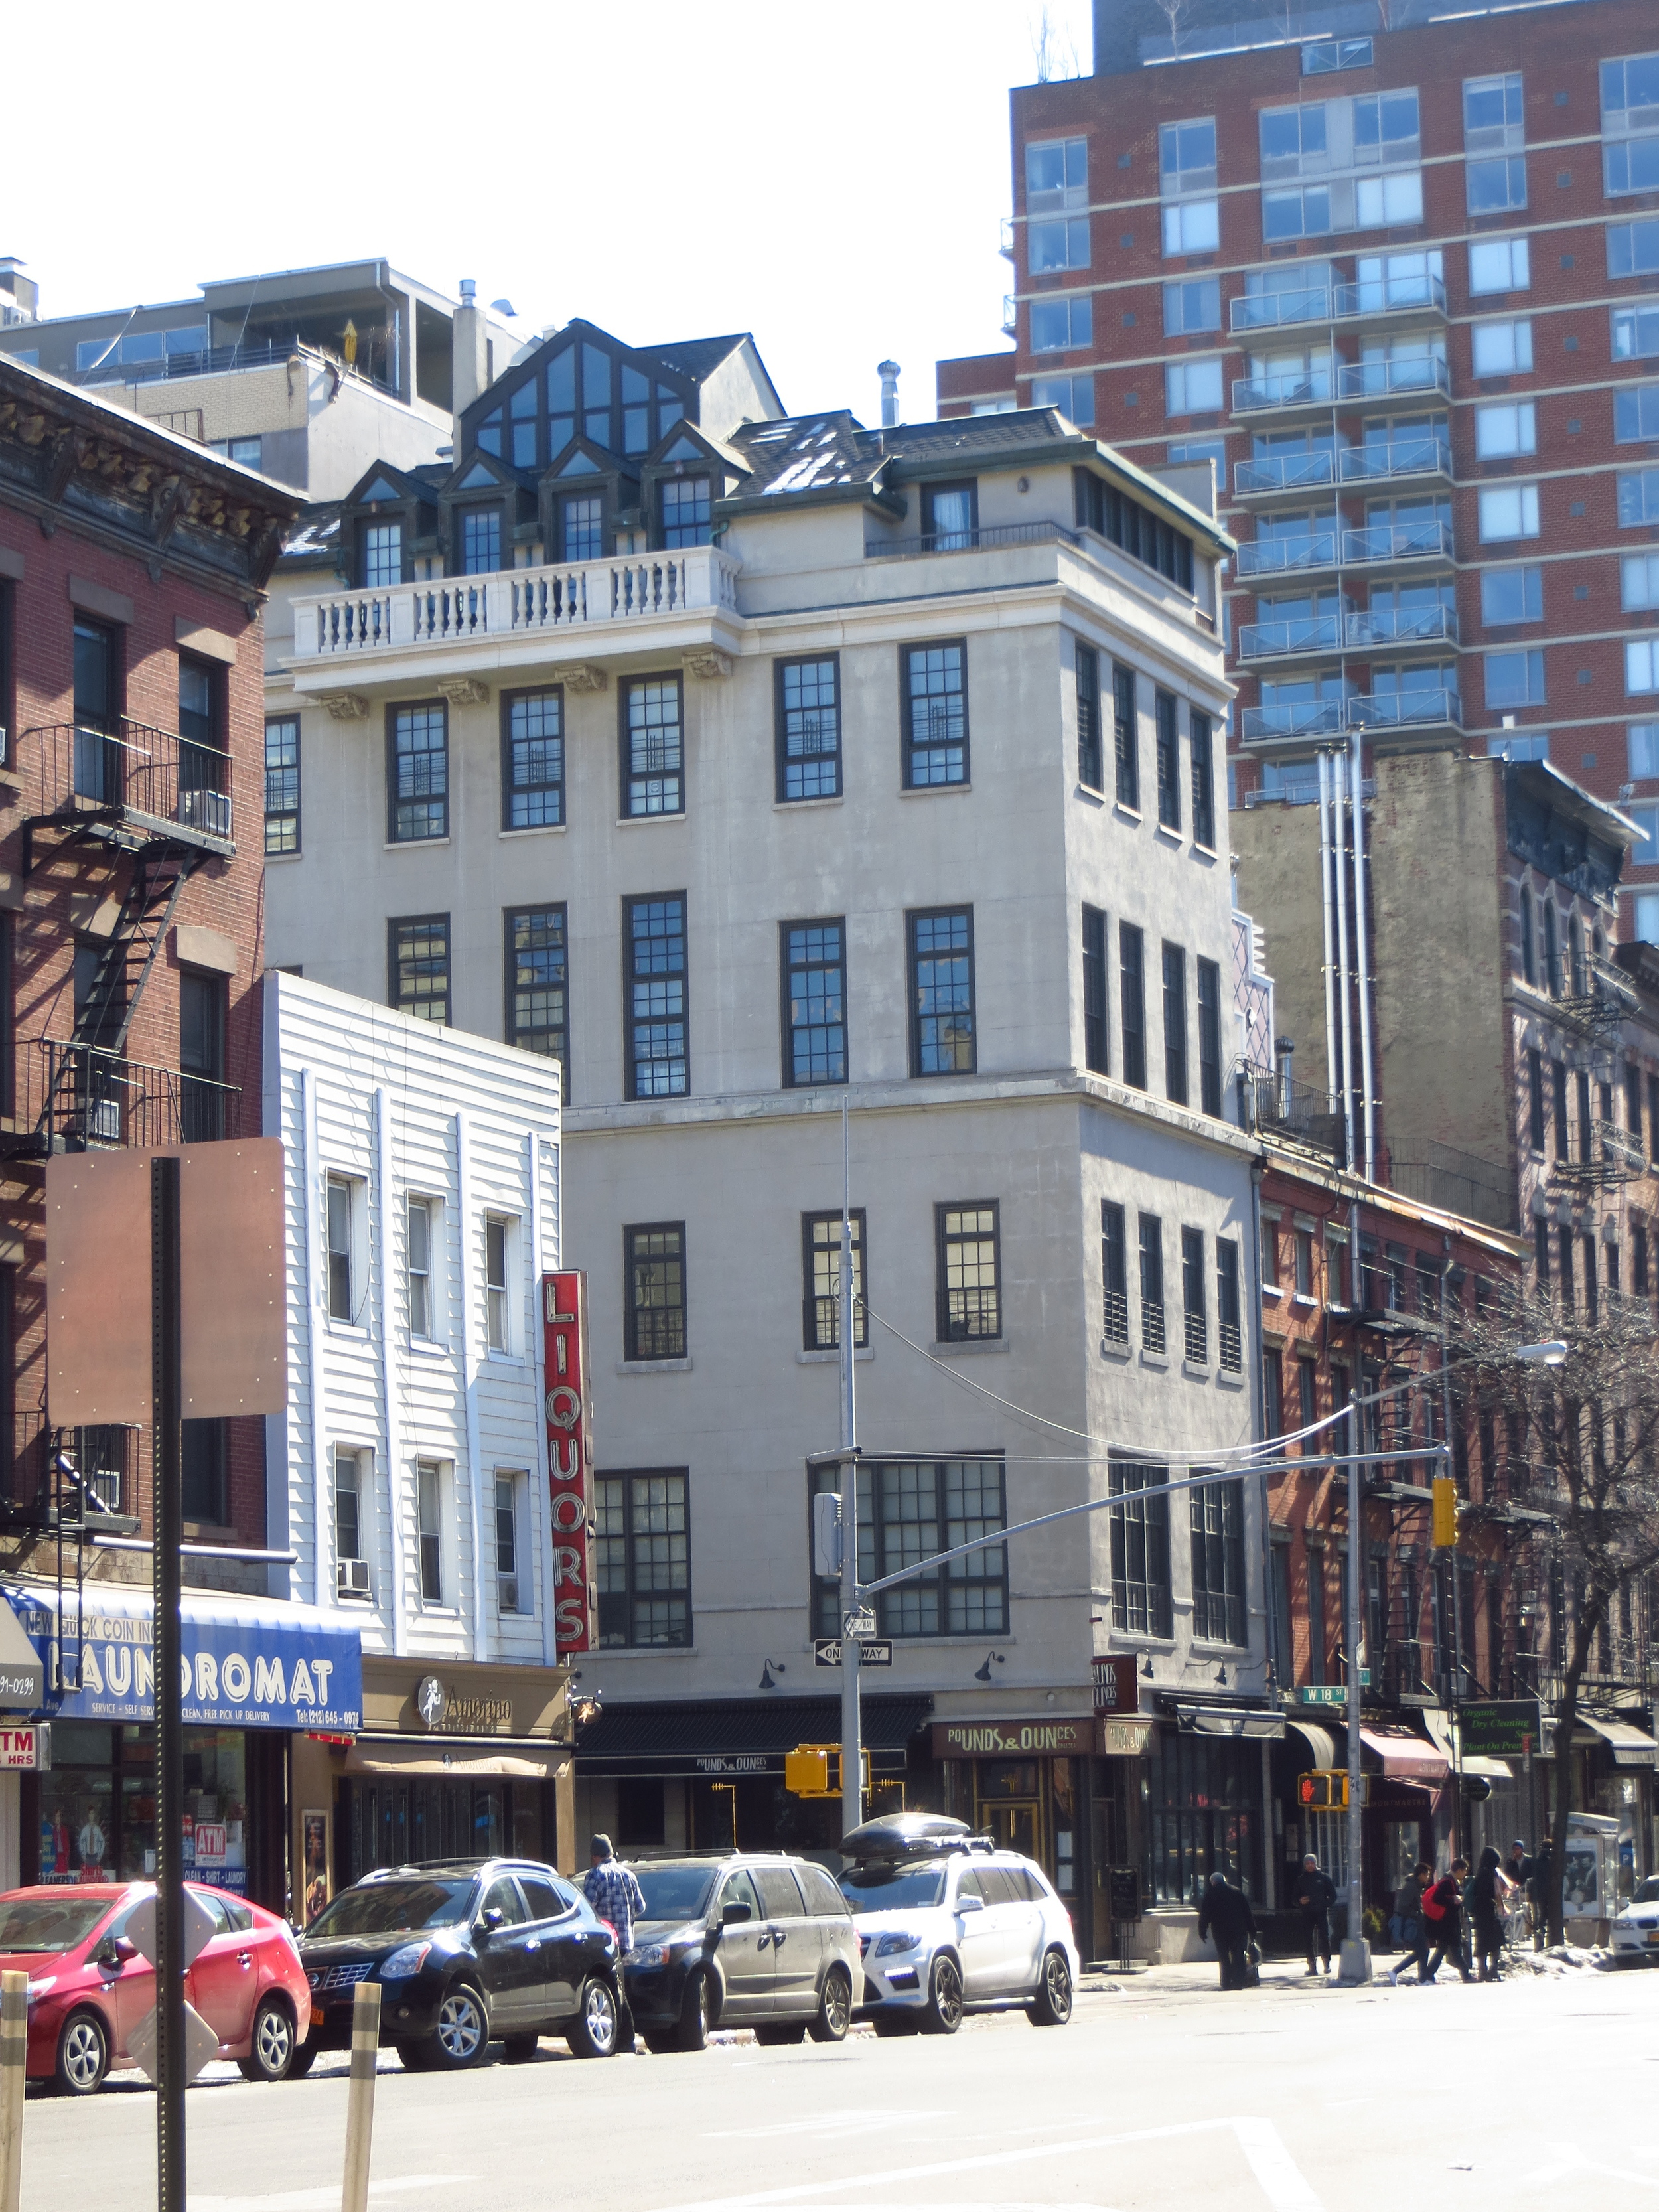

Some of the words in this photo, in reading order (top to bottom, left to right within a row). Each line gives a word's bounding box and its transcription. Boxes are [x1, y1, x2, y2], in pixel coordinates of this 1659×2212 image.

[545, 1282, 585, 1642] LIQUORS
[26, 1611, 53, 1634] NEW
[61, 1615, 98, 1638] QUCK
[103, 1619, 133, 1641] COIN
[863, 1619, 873, 1631] WAY
[861, 1648, 883, 1659] WAY
[1308, 1689, 1317, 1701] W
[1321, 1689, 1331, 1701] 18
[446, 1684, 511, 1720] Amorino
[92, 1702, 116, 1714] SERVICE
[125, 1704, 138, 1715] SELF
[140, 1705, 155, 1716] SERV
[181, 1708, 202, 1720] CLEAN,
[204, 1709, 218, 1719] FREE
[219, 1710, 233, 1720] PICK
[235, 1710, 242, 1720] UP
[245, 1710, 270, 1722] DELIVERY
[296, 1709, 308, 1723] Tel:
[309, 1710, 325, 1725] (212)
[325, 1710, 338, 1725] 645
[344, 1711, 359, 1725] 0974
[1463, 1708, 1497, 1719] Organic
[1473, 1719, 1487, 1729] Dry
[1490, 1718, 1529, 1728] Cleaning
[0, 1731, 33, 1751] TM
[1463, 1742, 1484, 1751] Plant
[1487, 1742, 1499, 1751] On
[8, 1755, 33, 1765] HRS
[198, 1828, 224, 1853] ATM
[80, 1863, 103, 1876] Shirts
[184, 1870, 201, 1883] CLEAN
[206, 1870, 220, 1883] SHIRT
[225, 1871, 246, 1883] LAUNDRY
